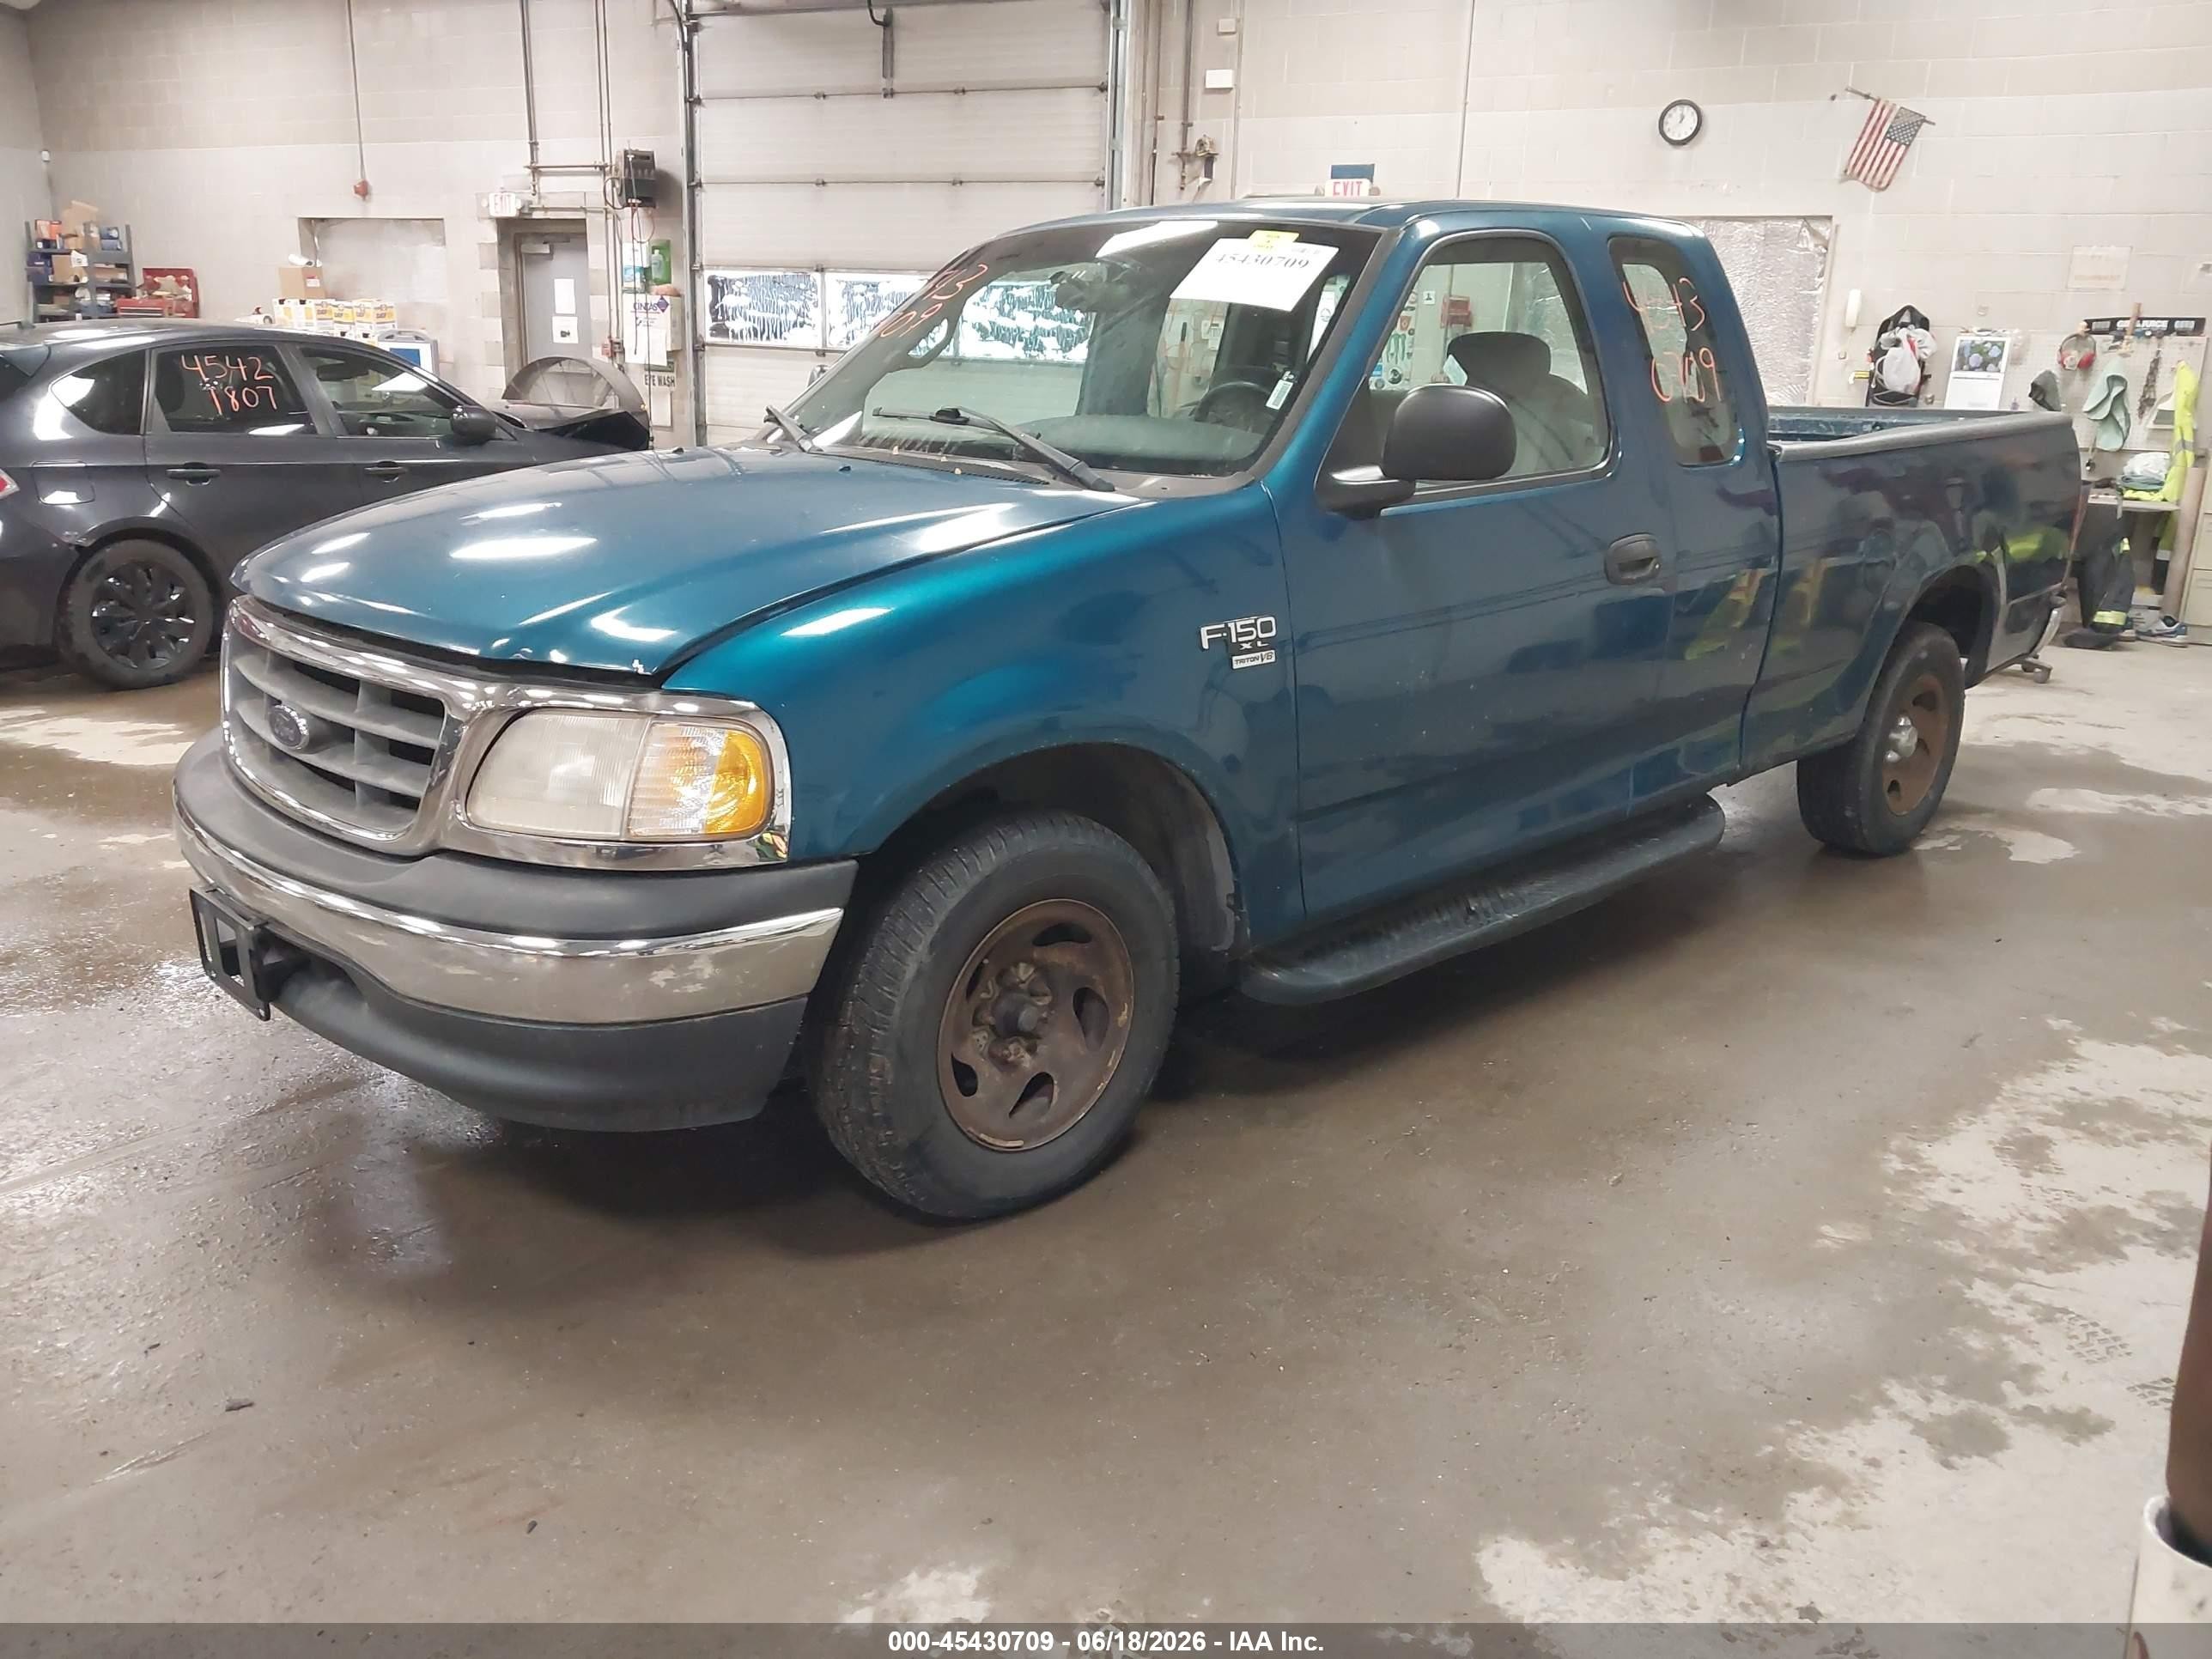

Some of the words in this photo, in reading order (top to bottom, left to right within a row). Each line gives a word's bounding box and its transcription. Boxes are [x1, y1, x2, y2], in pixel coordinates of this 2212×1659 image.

[181, 355, 274, 382] 4542
[207, 386, 277, 416] 1807
[1234, 656, 1260, 665] TRITON
